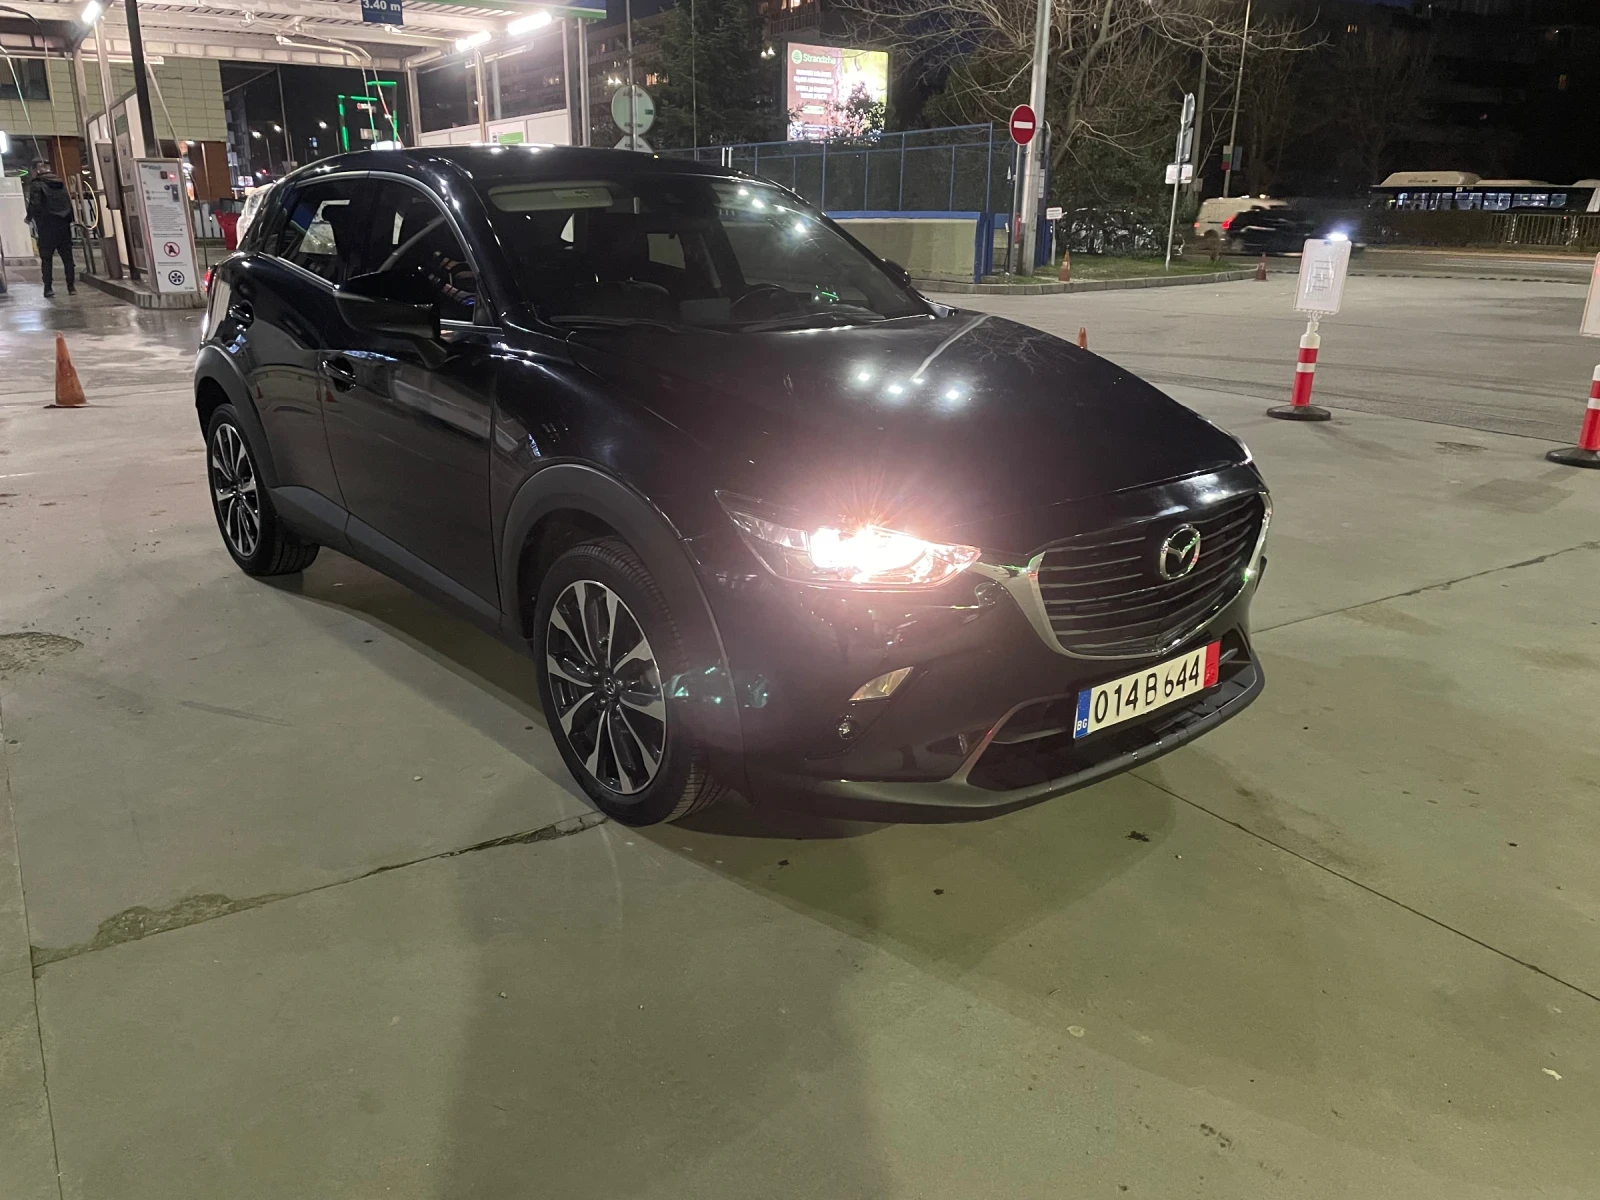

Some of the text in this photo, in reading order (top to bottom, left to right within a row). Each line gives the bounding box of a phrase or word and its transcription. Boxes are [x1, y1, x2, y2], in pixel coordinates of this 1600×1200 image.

[363, 0, 401, 12] 3.40 m
[1076, 718, 1088, 732] BG
